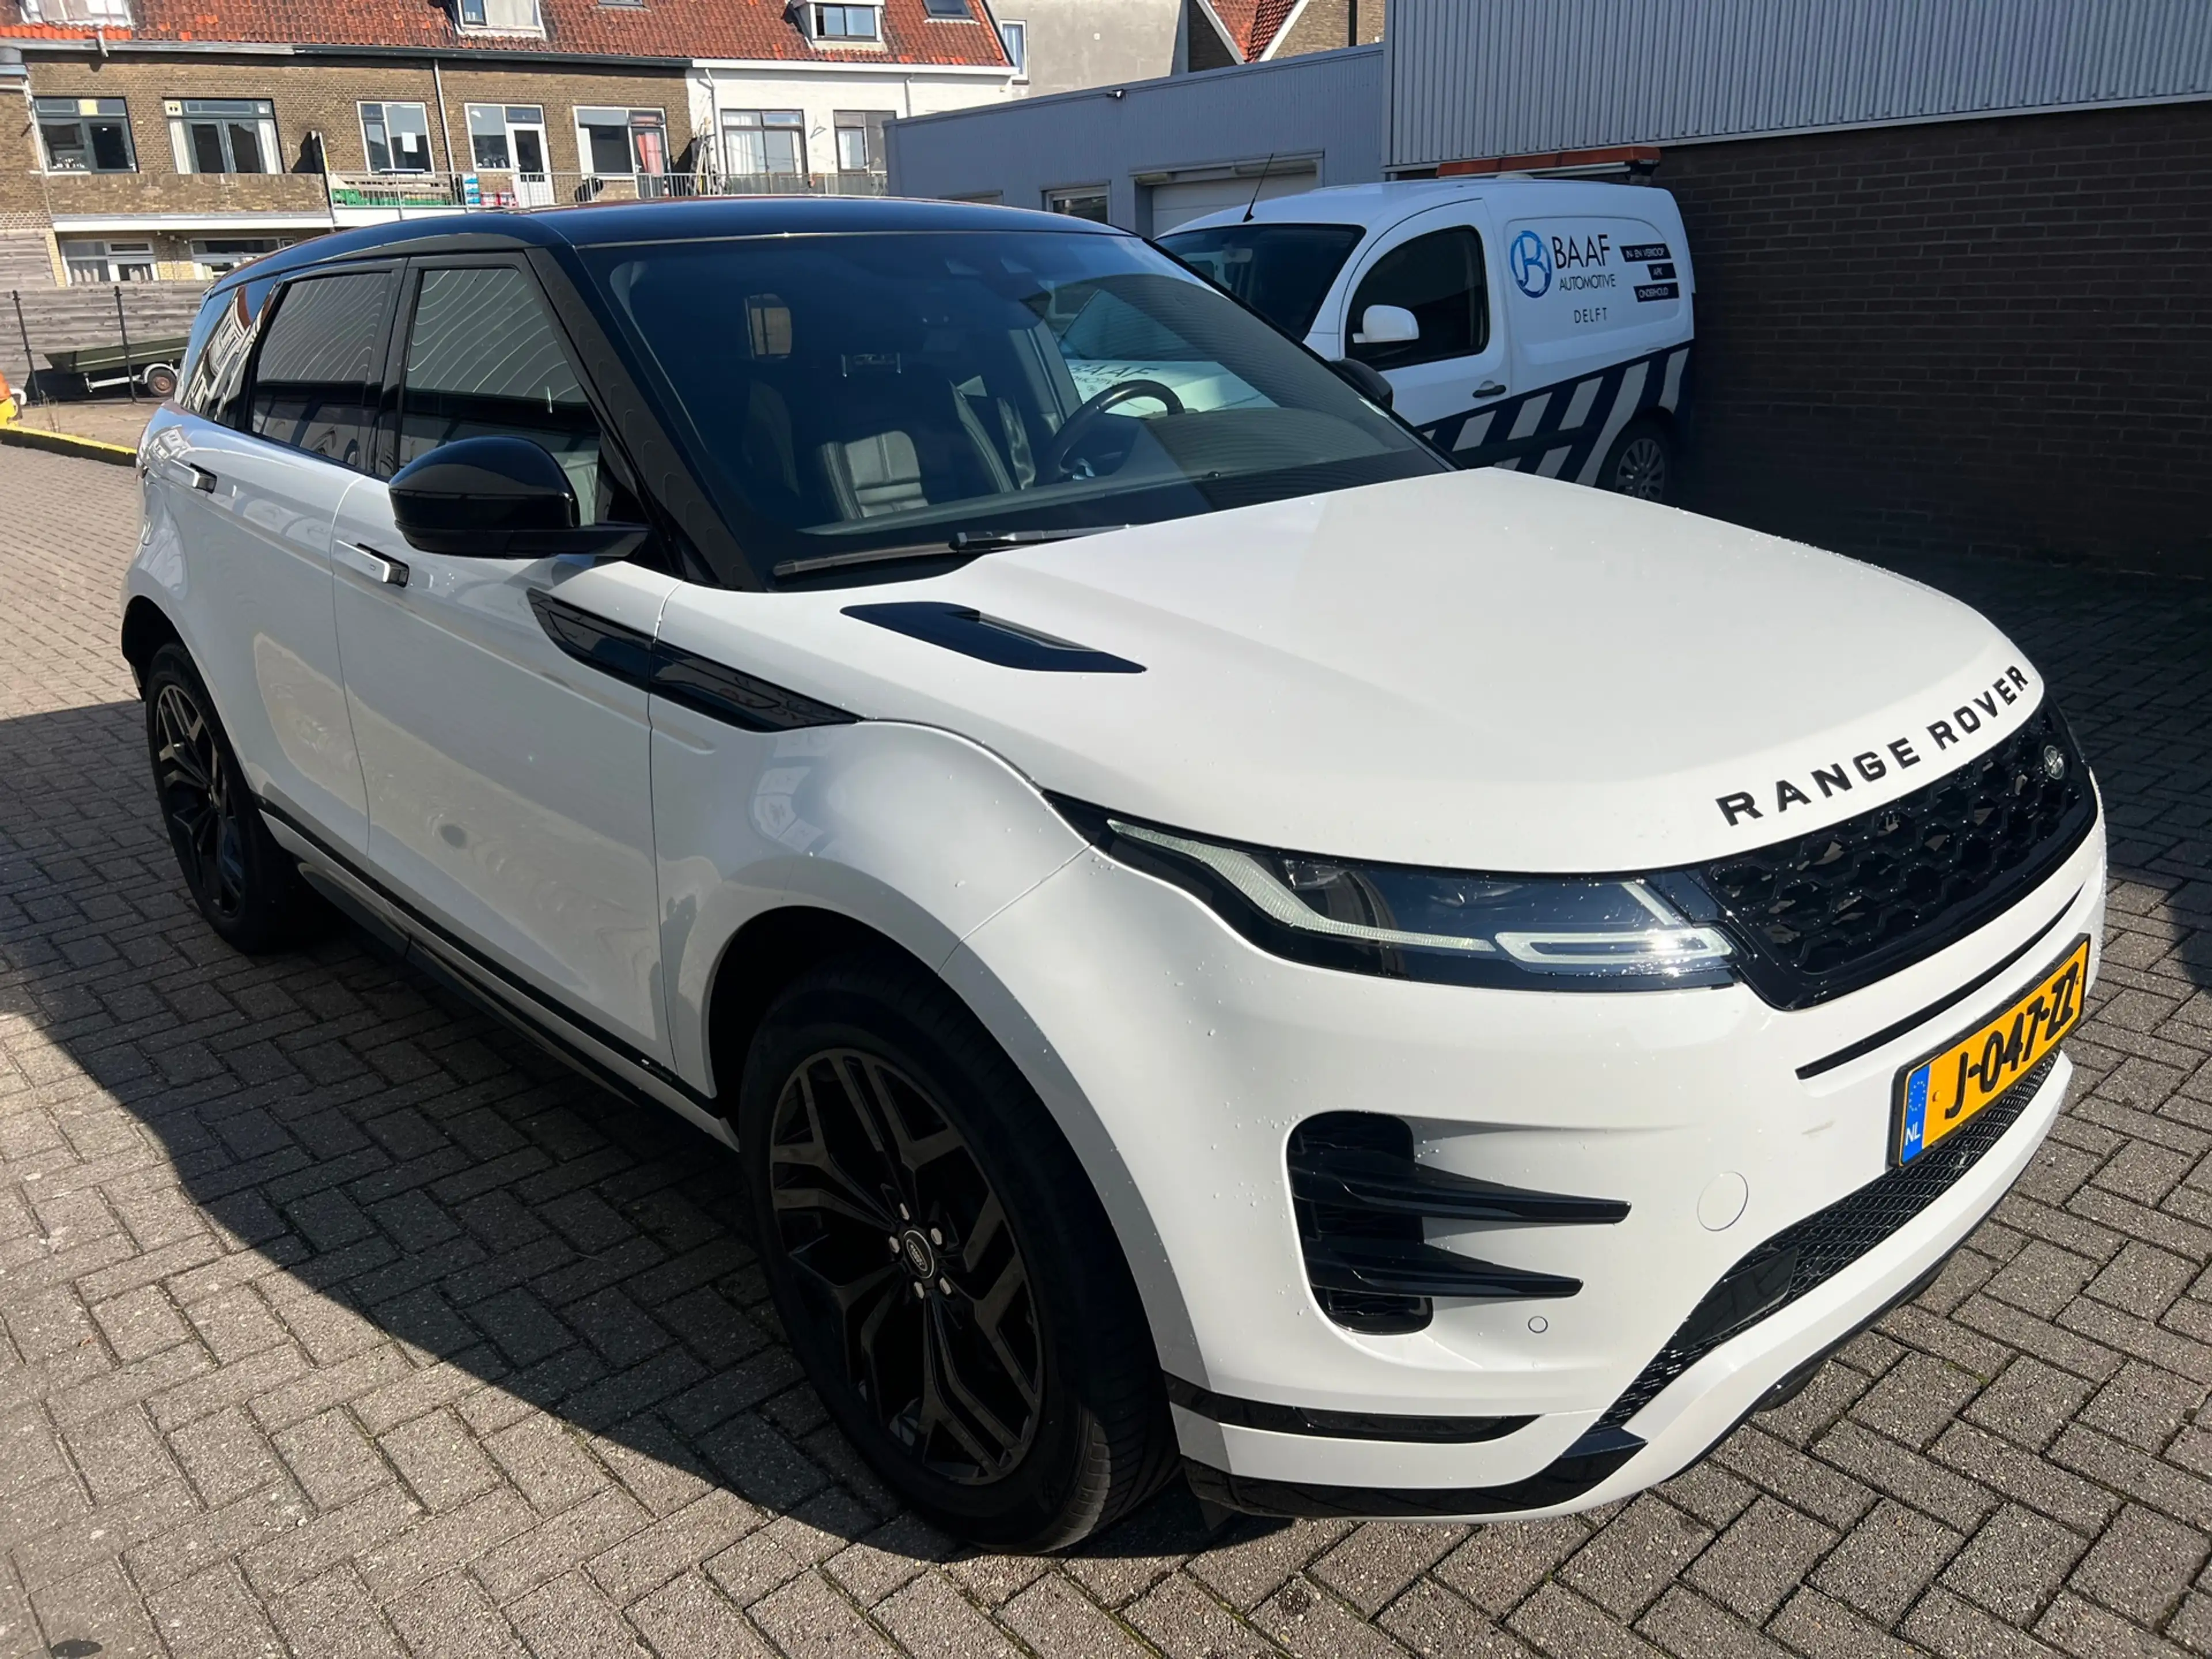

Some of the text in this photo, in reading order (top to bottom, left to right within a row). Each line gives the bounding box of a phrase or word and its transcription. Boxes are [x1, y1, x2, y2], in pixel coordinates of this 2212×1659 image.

[1551, 234, 1611, 269] BAAF
[1559, 274, 1616, 291] AUTOMOTIVE
[1574, 307, 1607, 323] DELFT
[1715, 665, 2029, 827] RANGE ROVER
[1944, 961, 2080, 1119] J-047-ZZ
[1905, 1122, 1921, 1146] NL
